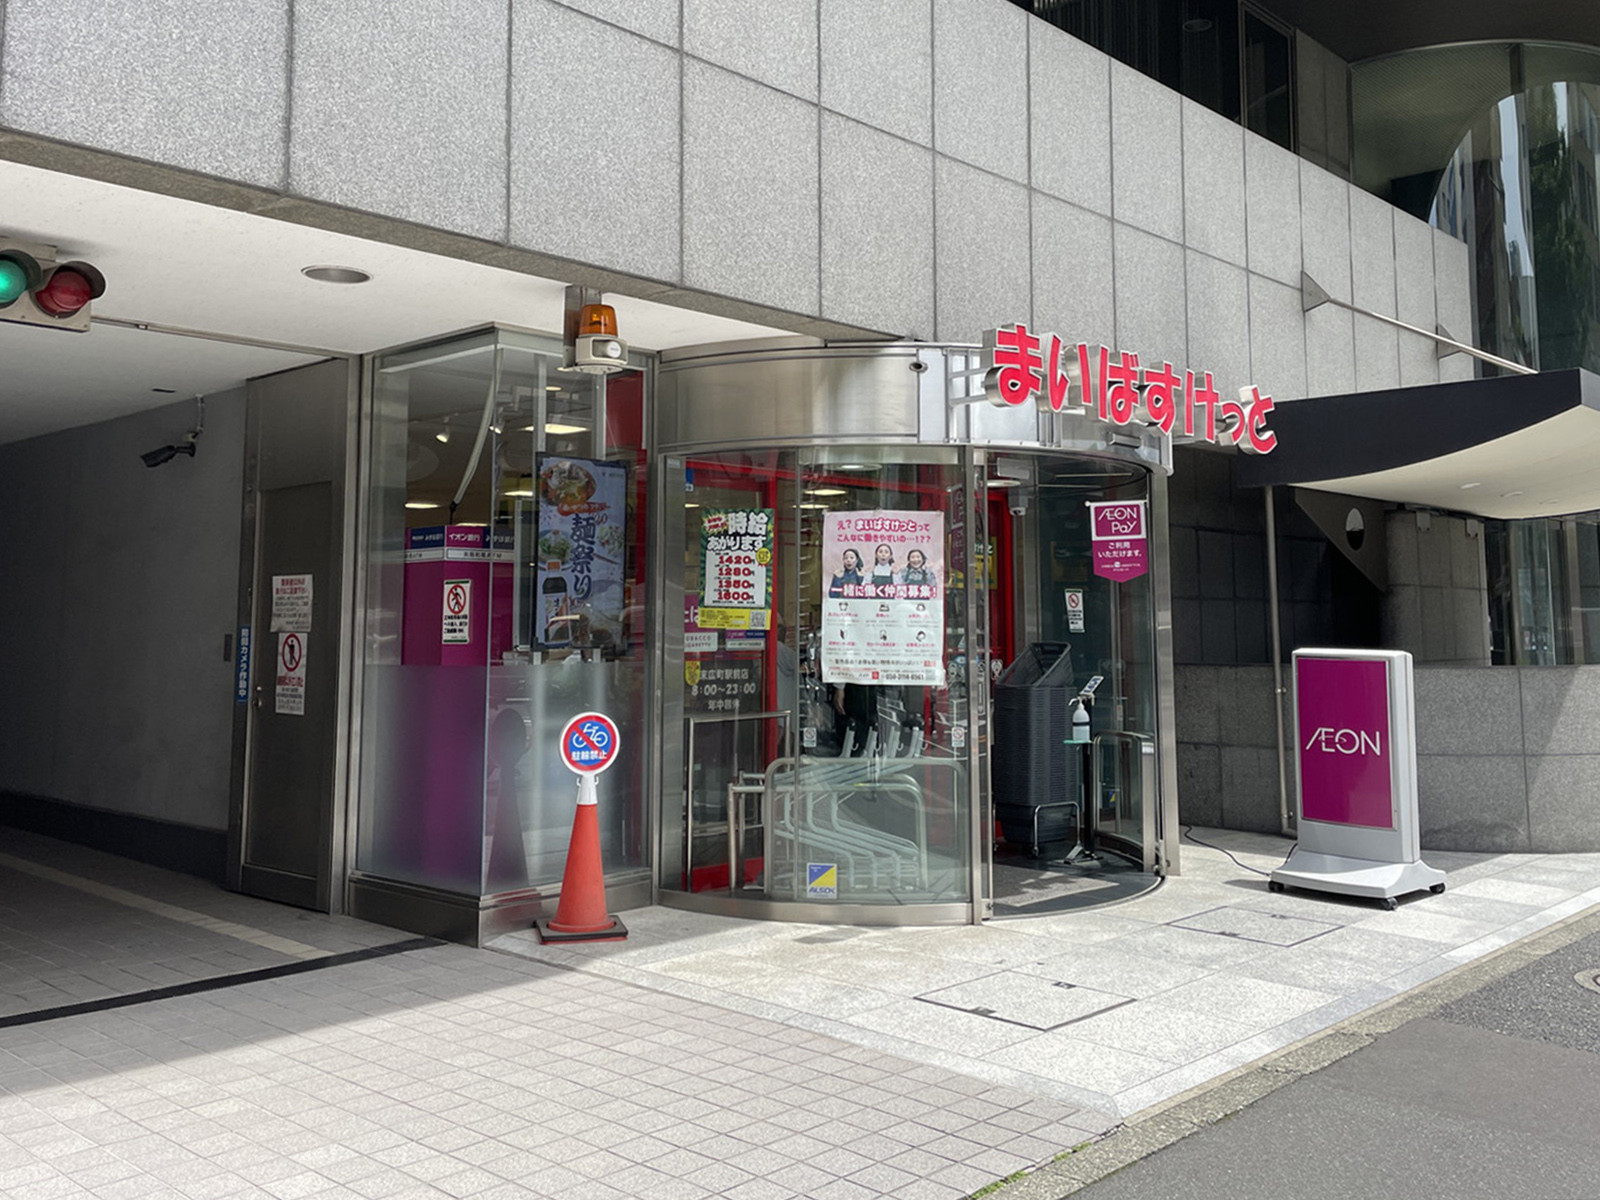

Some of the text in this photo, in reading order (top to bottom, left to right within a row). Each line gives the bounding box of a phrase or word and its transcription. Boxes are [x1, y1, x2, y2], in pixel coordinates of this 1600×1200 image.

[989, 322, 1278, 455] まいばすけっと
[727, 511, 769, 536] 時給
[1111, 521, 1137, 534] Pay
[448, 532, 481, 543] イオン銀行
[706, 535, 767, 552] あがります
[1108, 541, 1131, 550] ご利用
[569, 513, 596, 600] 麺祭り
[571, 749, 608, 761] 駐輪禁止
[808, 886, 836, 895] ALSOK
